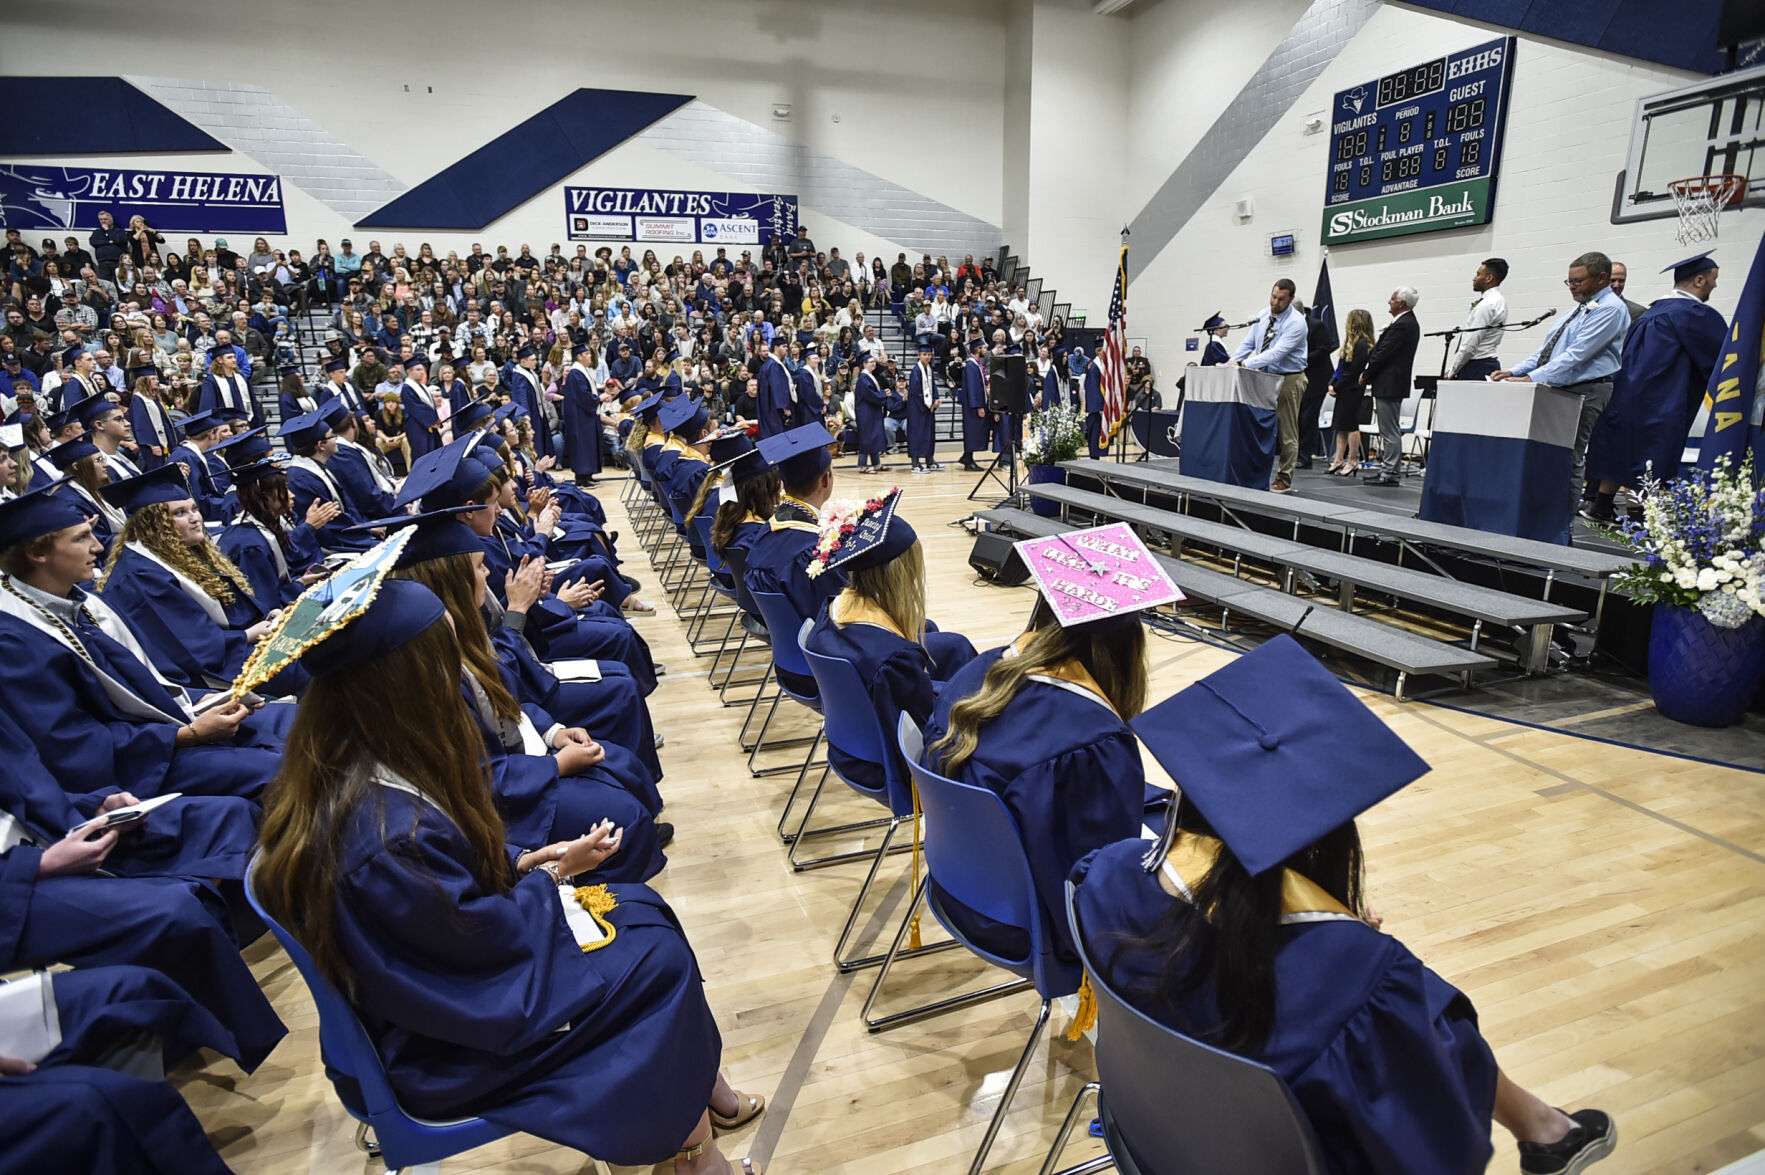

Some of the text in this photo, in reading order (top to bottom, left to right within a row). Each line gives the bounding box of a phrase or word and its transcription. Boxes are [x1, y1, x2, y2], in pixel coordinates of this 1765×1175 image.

[1448, 47, 1502, 80] EHHS
[1450, 80, 1486, 102] GUEST
[1395, 106, 1419, 120] PERIOD
[1334, 112, 1378, 135] VIGILANTES
[1434, 137, 1452, 149] T.O.L.
[1460, 128, 1485, 142] FOULS
[1381, 143, 1424, 162] FOUL PLAYER
[1334, 161, 1352, 173] FOULS
[1456, 166, 1480, 179] SCORE
[89, 172, 281, 202] EAST HELENA
[1381, 179, 1418, 194] ADVANTAGE
[571, 190, 711, 215] VIGILANTES
[1331, 192, 1350, 203] SCORE
[783, 202, 797, 237] Band
[1353, 205, 1423, 230] Stockman
[1428, 191, 1474, 217] Bank
[1043, 547, 1087, 570] LIKE
